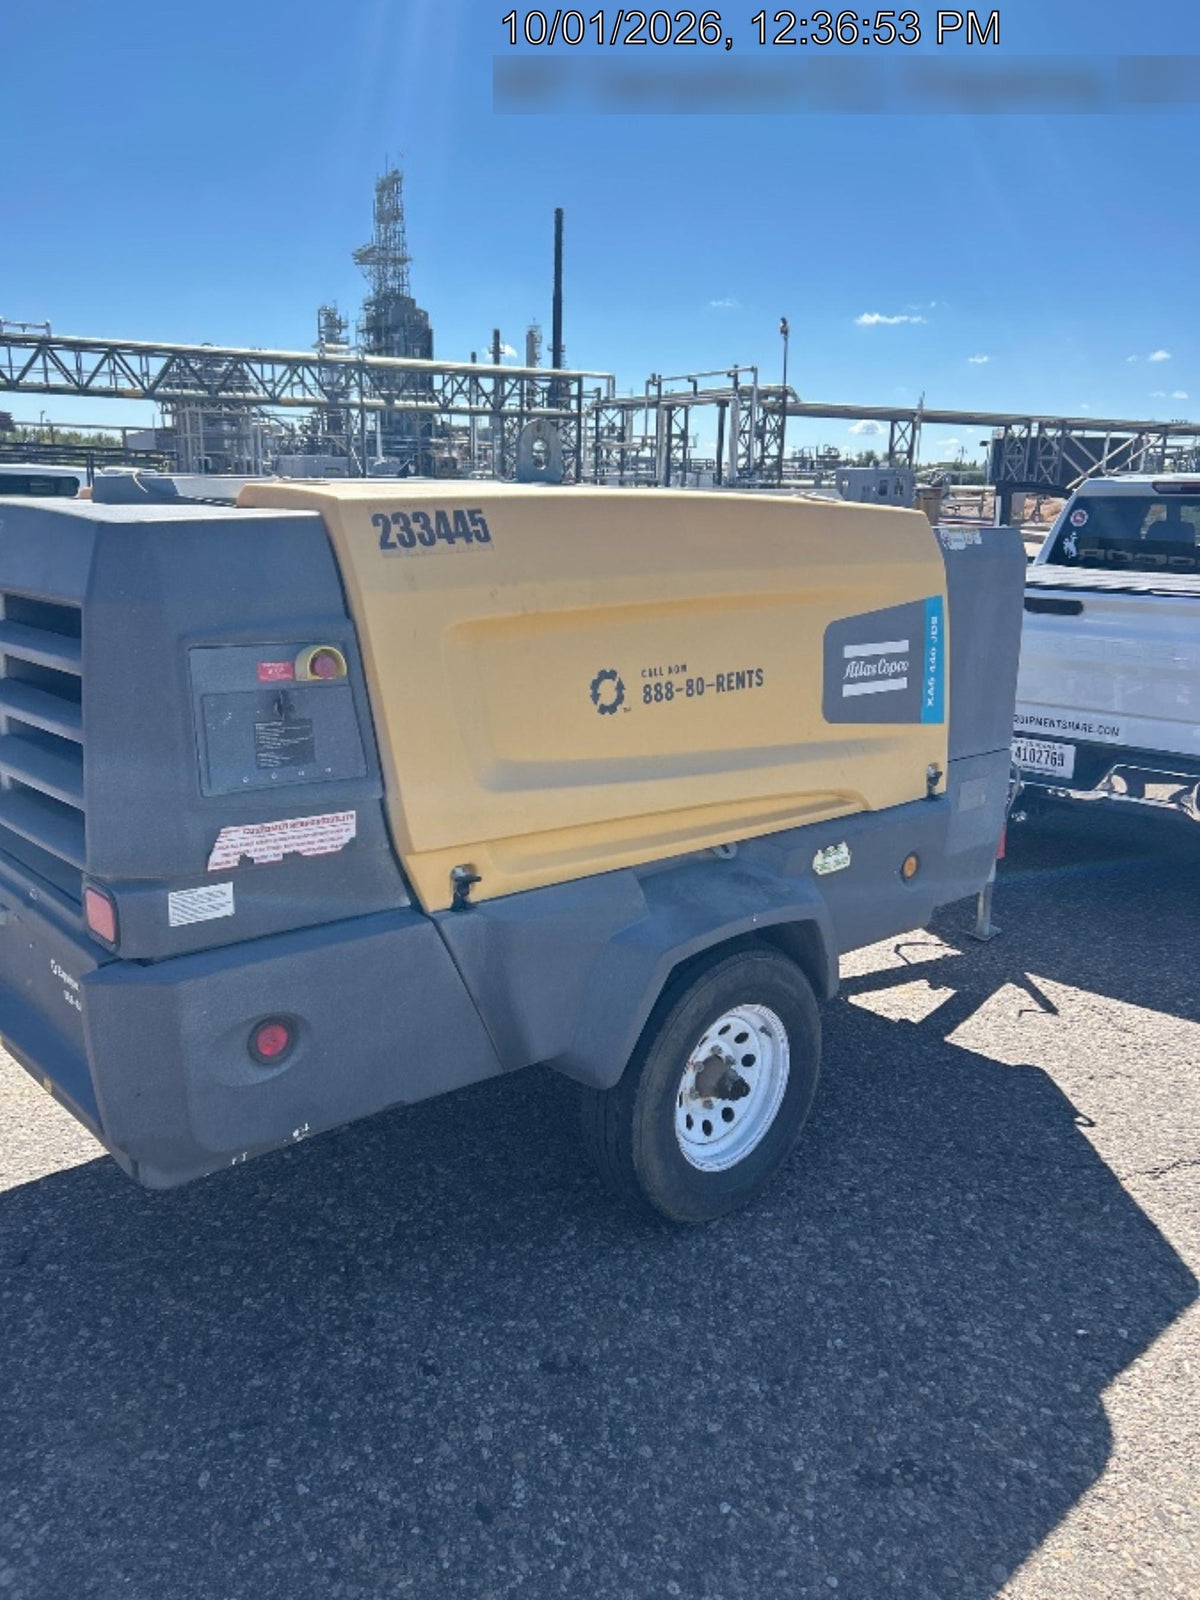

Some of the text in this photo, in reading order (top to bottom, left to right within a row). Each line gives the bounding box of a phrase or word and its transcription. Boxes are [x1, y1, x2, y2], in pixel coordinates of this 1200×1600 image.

[371, 508, 492, 550] 233445
[641, 666, 664, 678] CALL
[842, 658, 910, 680] Atlas Copco
[642, 668, 764, 704] 888-80-RENTS
